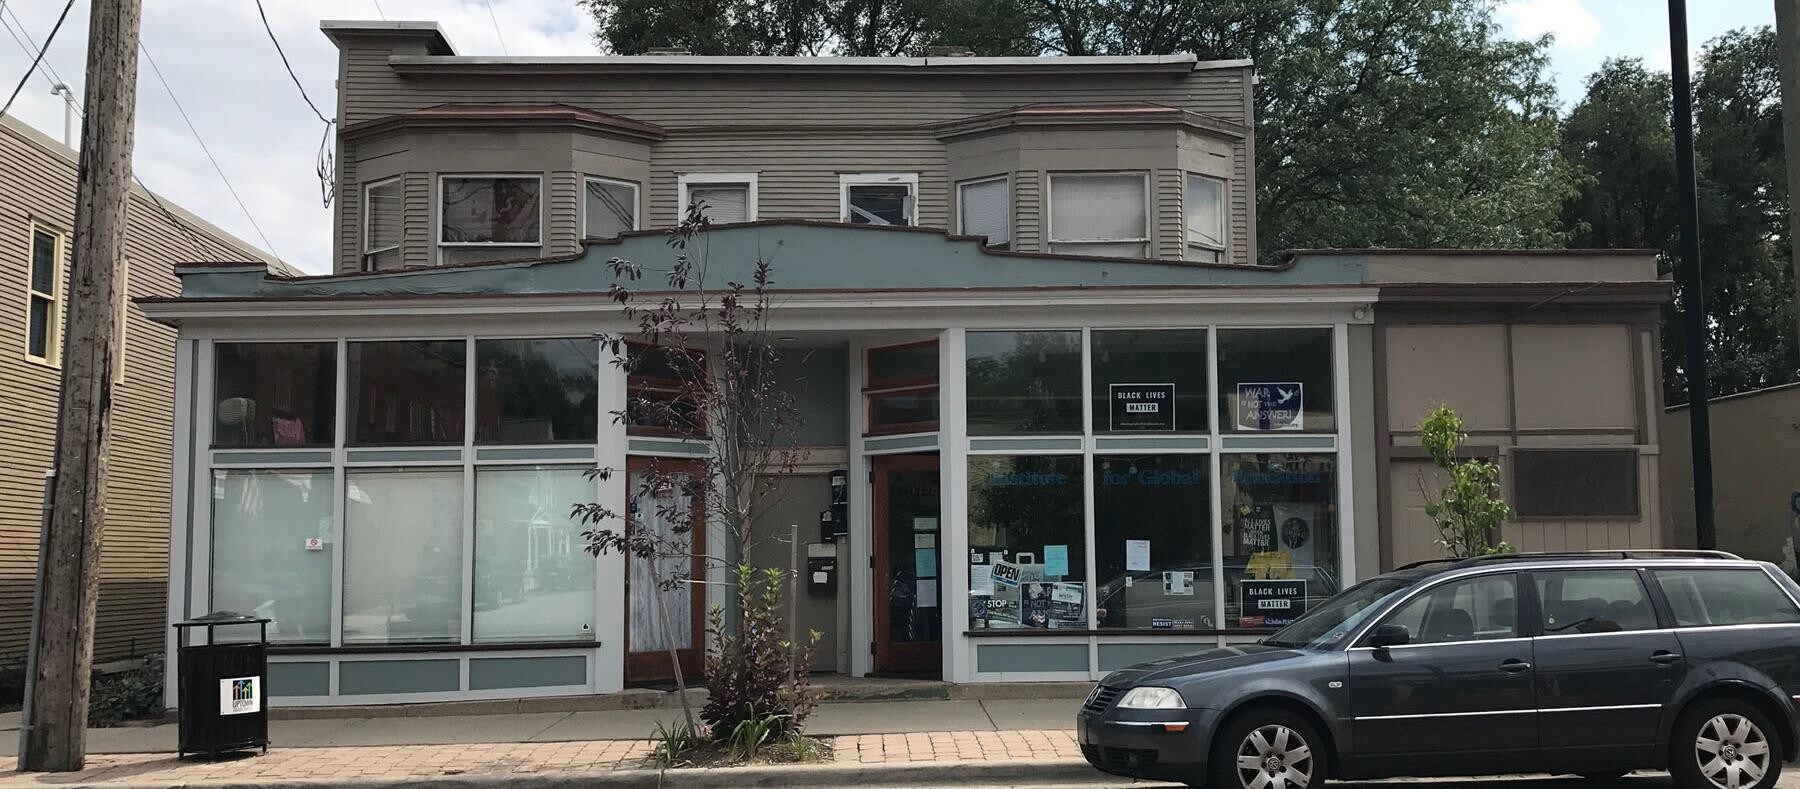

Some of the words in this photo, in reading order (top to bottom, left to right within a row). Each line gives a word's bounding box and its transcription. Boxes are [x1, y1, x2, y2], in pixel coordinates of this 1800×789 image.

[1145, 391, 1166, 399] LIVES
[1244, 387, 1270, 399] WAR
[1129, 403, 1157, 412] MATTER
[1248, 400, 1263, 409] NOT
[994, 563, 1020, 581] OPEN
[1277, 587, 1298, 595] LIVES
[987, 599, 1007, 608] STOP
[232, 699, 253, 708] UPTOWN
